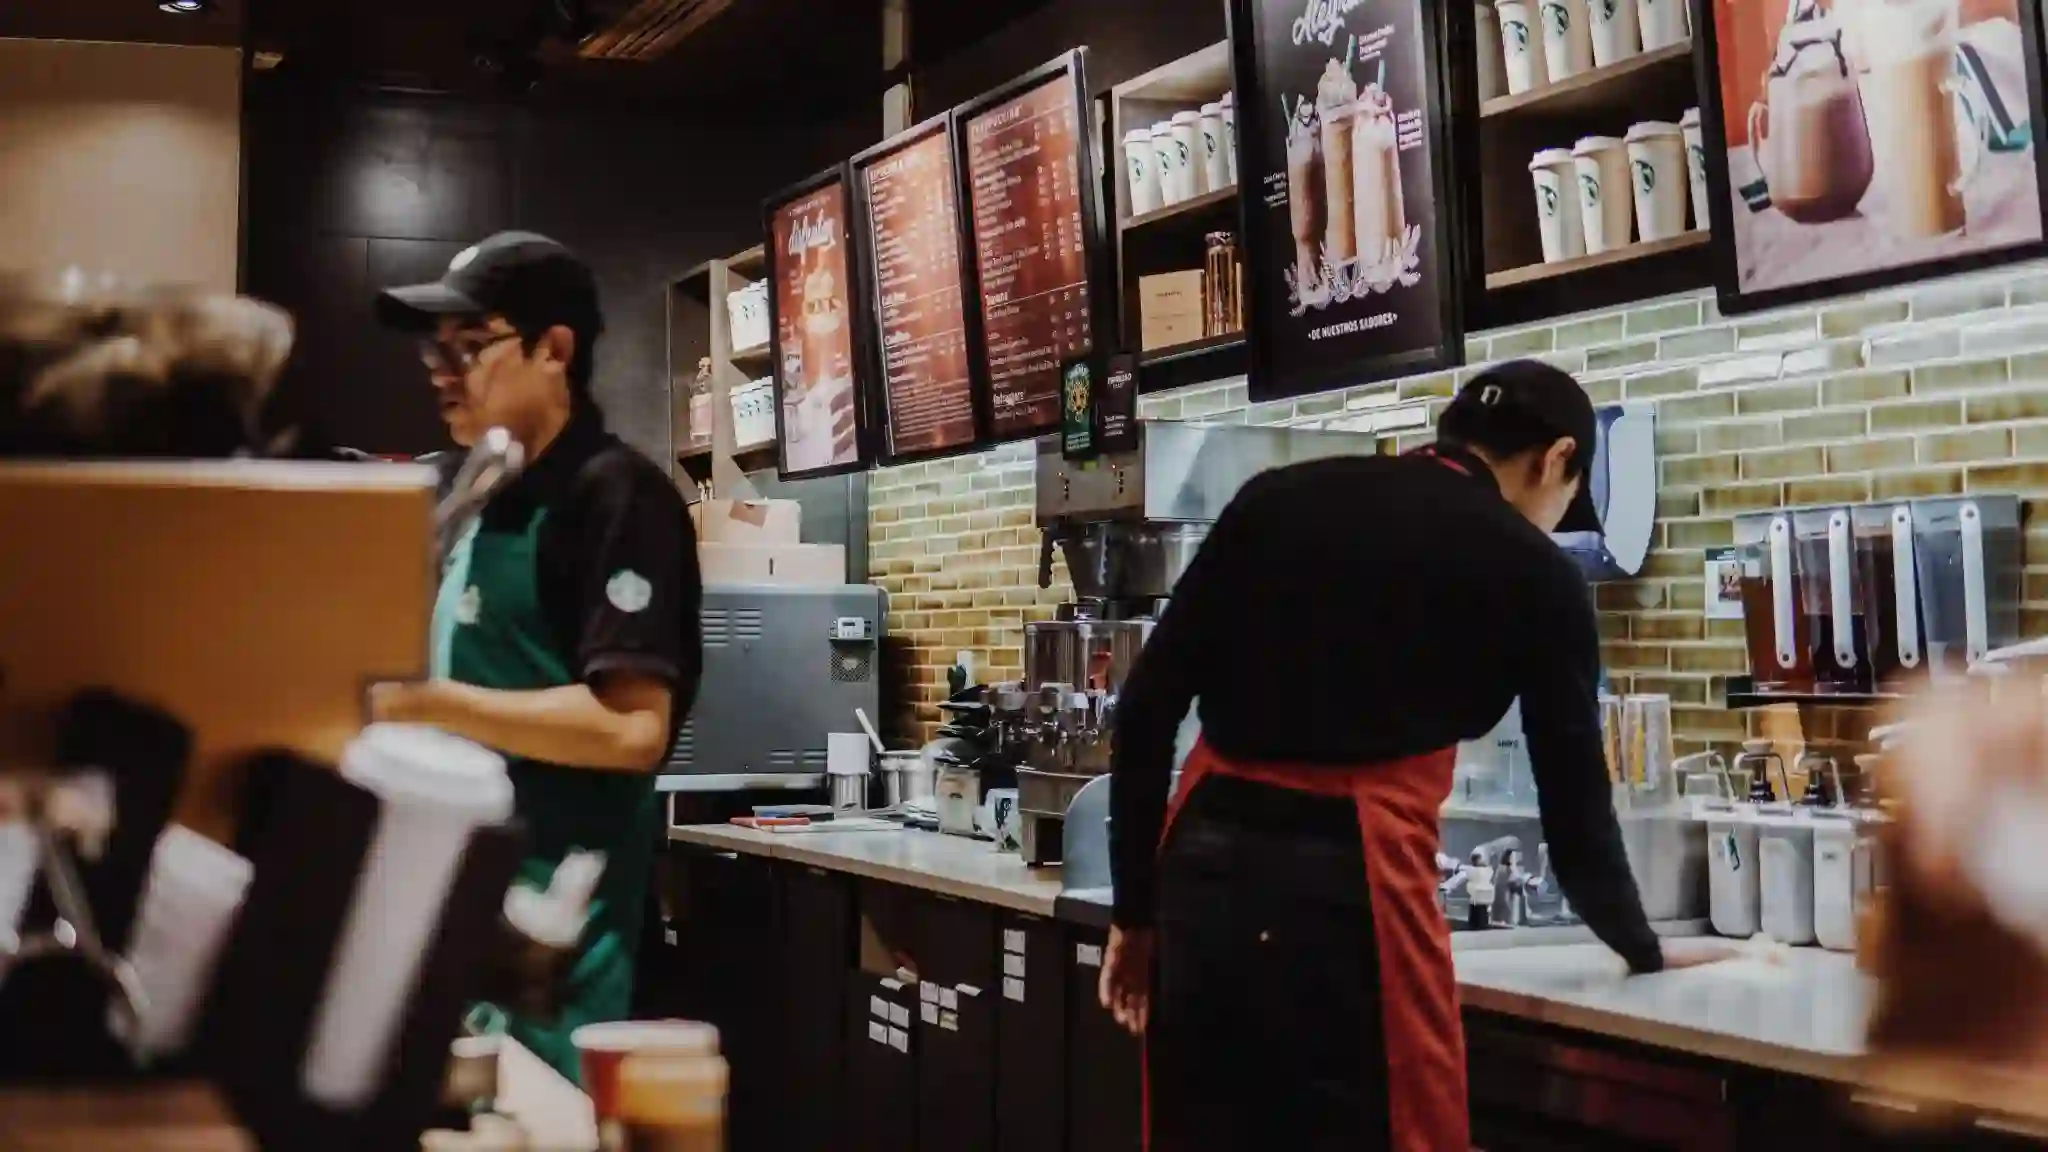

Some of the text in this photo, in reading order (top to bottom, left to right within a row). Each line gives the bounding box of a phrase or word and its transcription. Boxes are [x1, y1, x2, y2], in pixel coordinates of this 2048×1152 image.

[1311, 312, 1393, 340] DE NUESTROS SABORES
